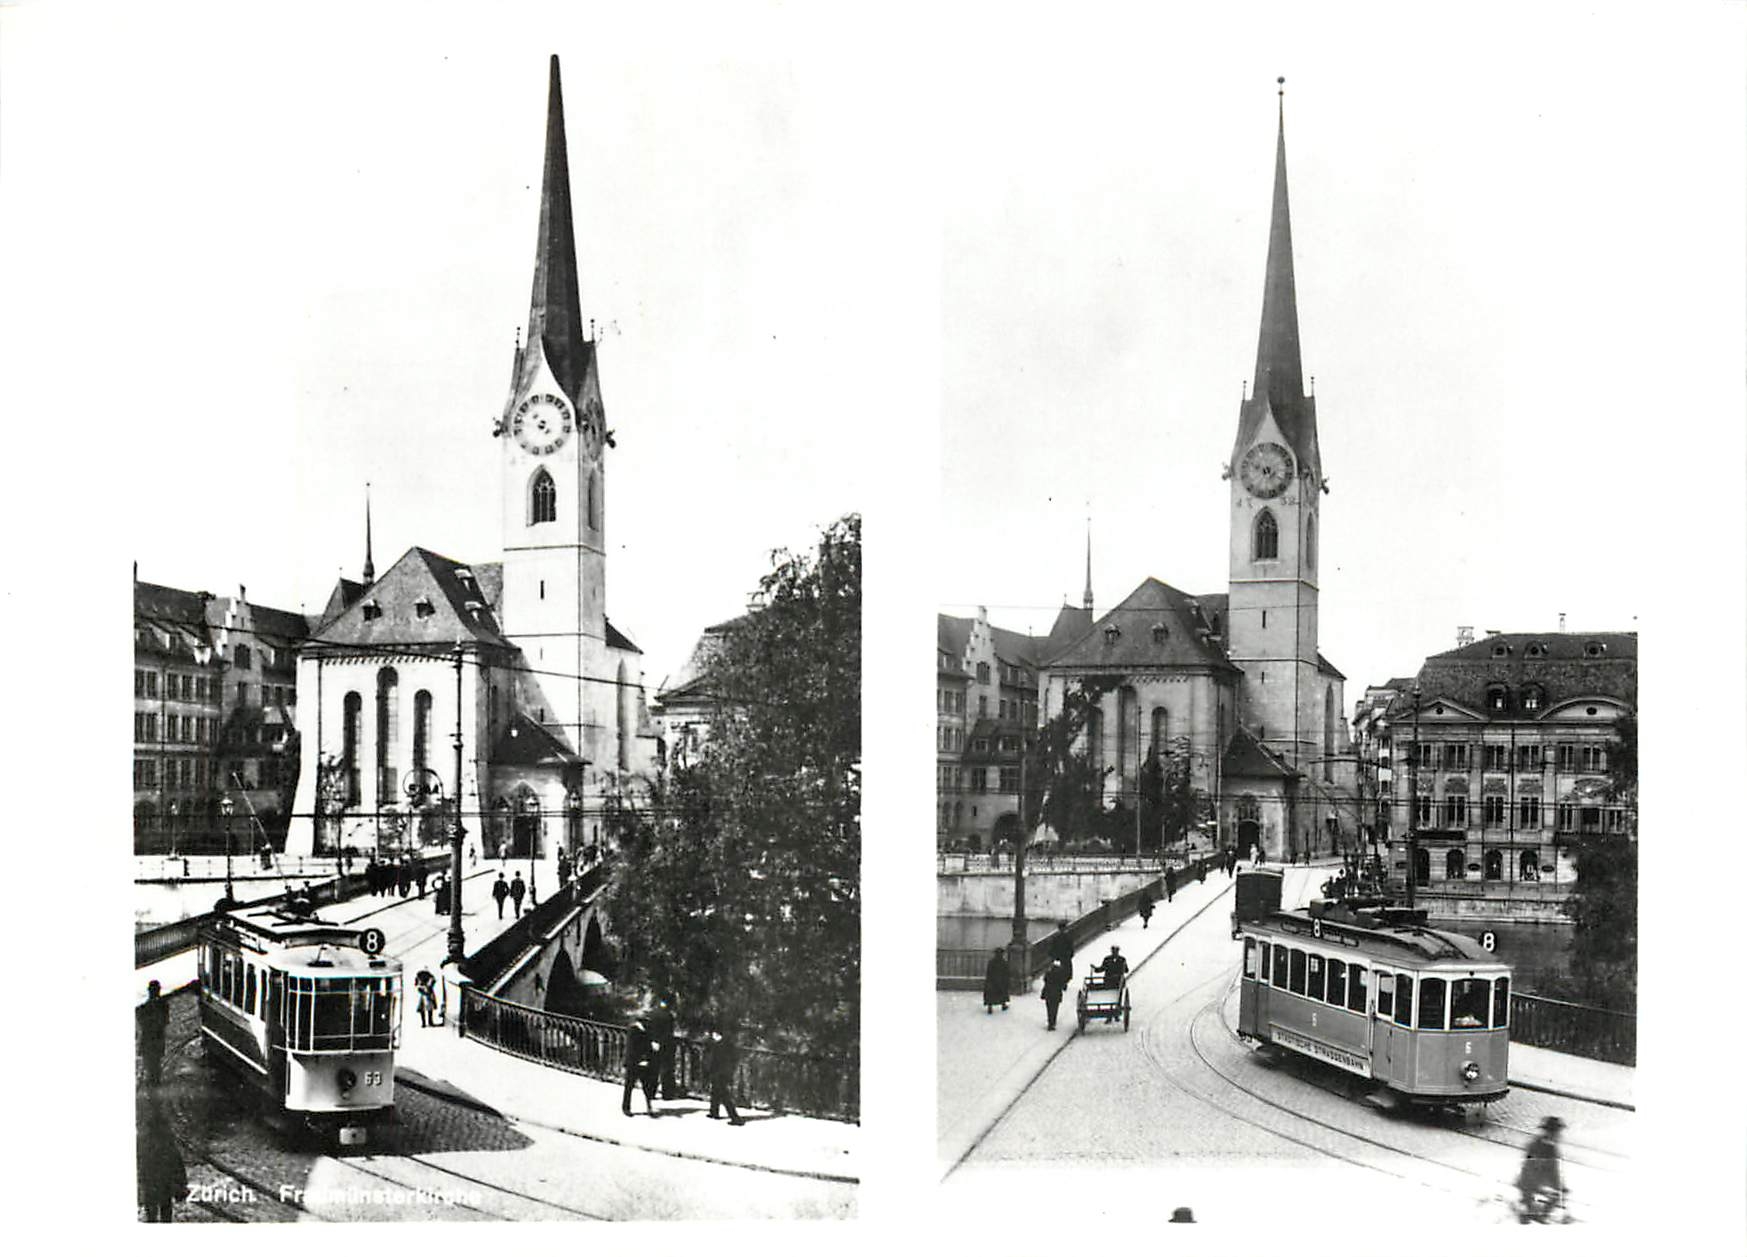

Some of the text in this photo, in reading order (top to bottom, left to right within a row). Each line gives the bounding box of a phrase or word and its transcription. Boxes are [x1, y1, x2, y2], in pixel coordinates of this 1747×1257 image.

[1313, 918, 1321, 937] 8
[366, 931, 379, 950] 8
[1483, 931, 1495, 952] 8
